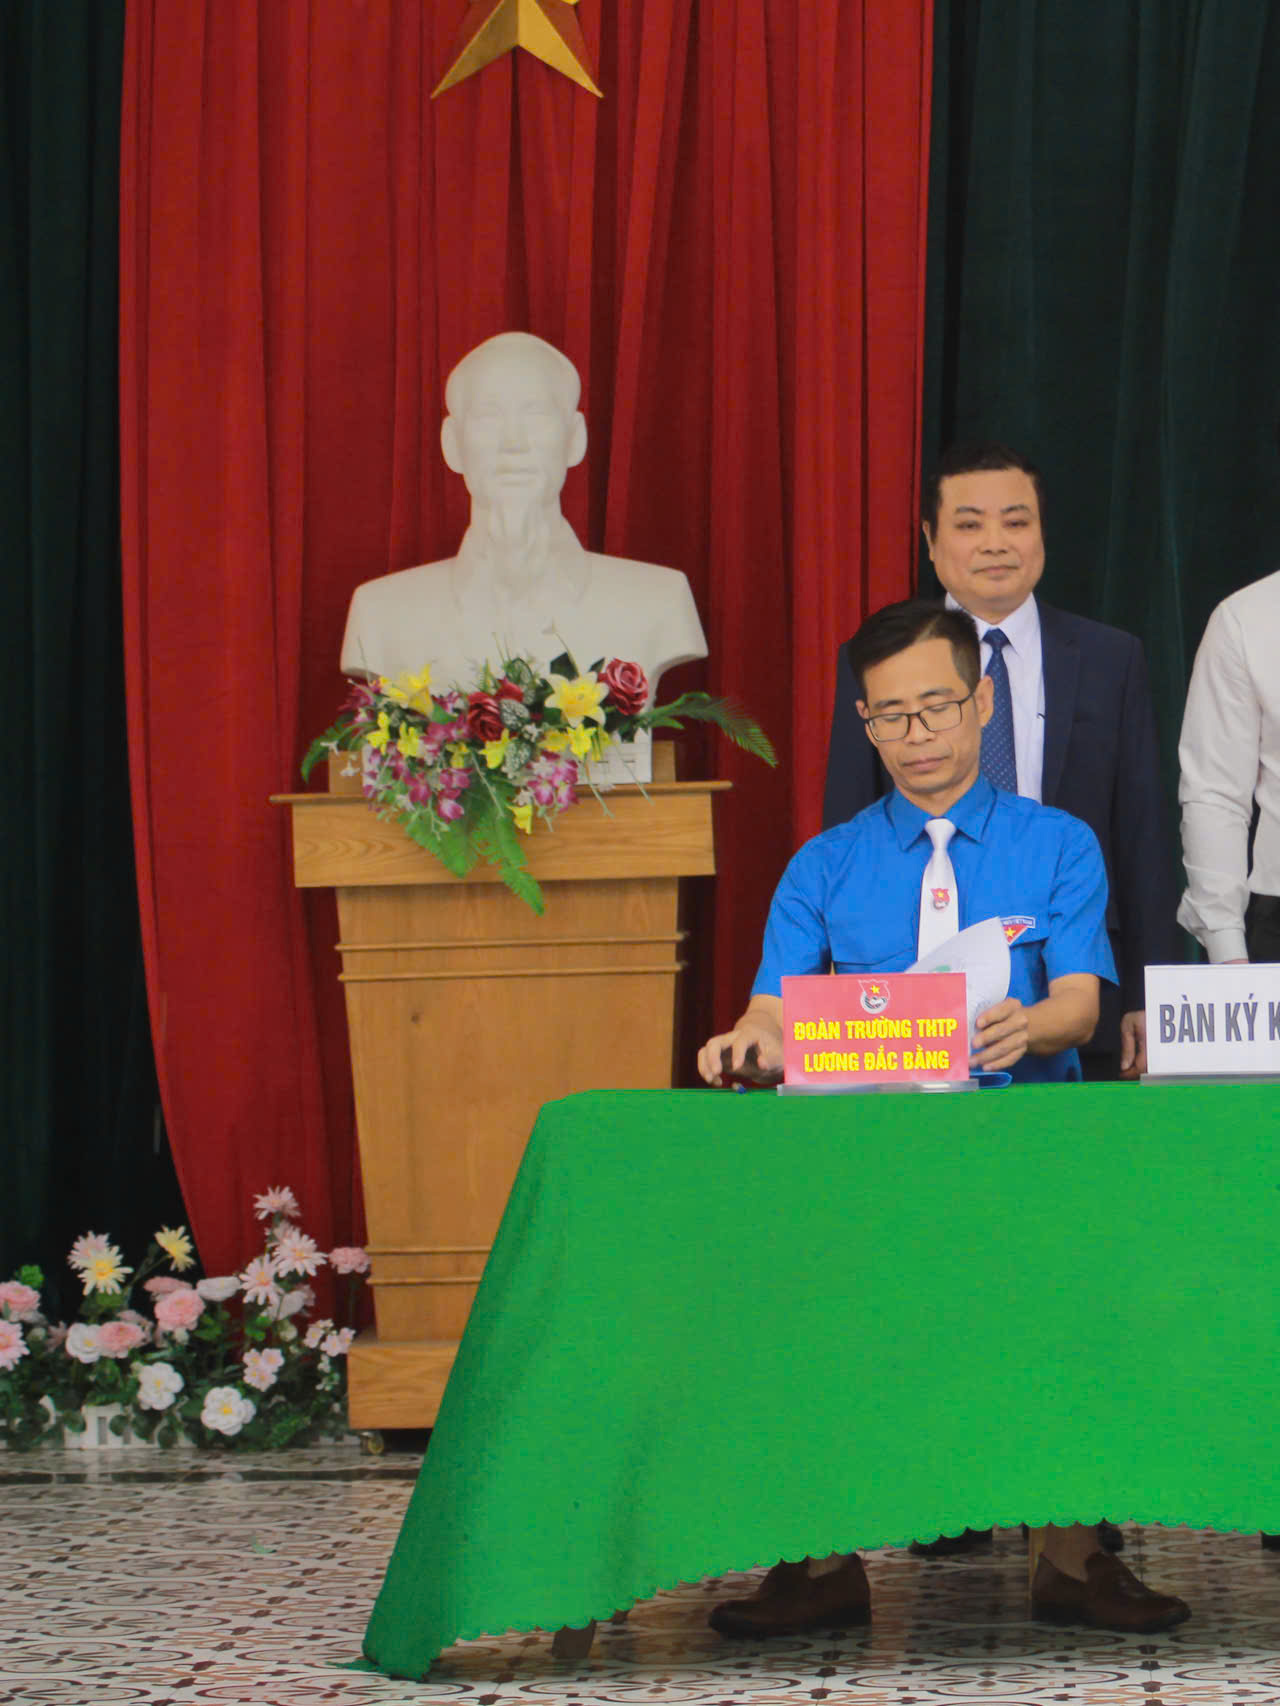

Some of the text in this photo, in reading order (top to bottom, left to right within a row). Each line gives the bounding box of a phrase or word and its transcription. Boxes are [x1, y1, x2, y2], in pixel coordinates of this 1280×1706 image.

[793, 1015, 958, 1041] ĐOÀN TRƯỜNG THTP
[1159, 994, 1216, 1044] BÀN
[1224, 992, 1259, 1043] KÝ
[803, 1044, 950, 1073] LƯƠNG ĐẮC BẰNG
